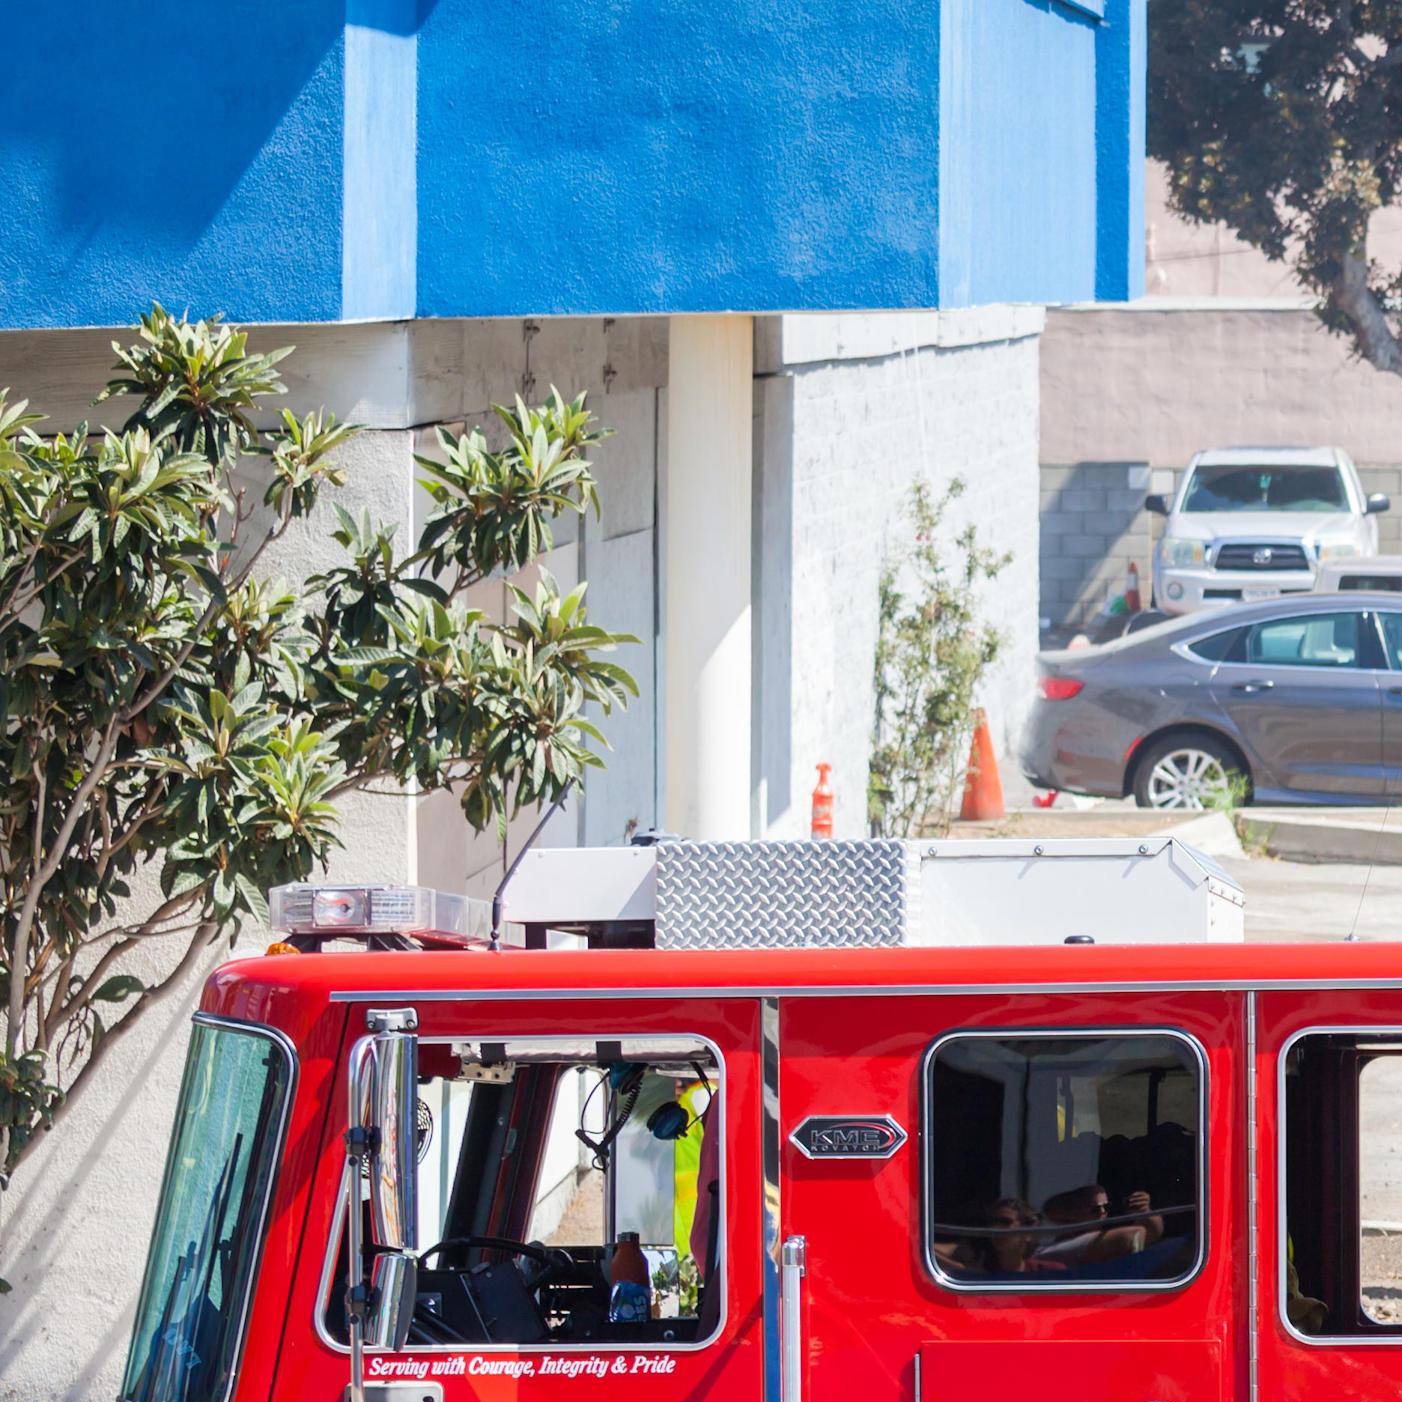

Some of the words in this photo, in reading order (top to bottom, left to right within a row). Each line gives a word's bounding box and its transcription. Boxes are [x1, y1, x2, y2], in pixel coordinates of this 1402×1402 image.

[811, 1129, 880, 1145] KME
[369, 1357, 430, 1379] Serving
[431, 1356, 466, 1376] with
[468, 1356, 535, 1378] Courage,
[538, 1355, 609, 1378] Integrity
[610, 1356, 628, 1374] &
[630, 1355, 677, 1374] Pride
